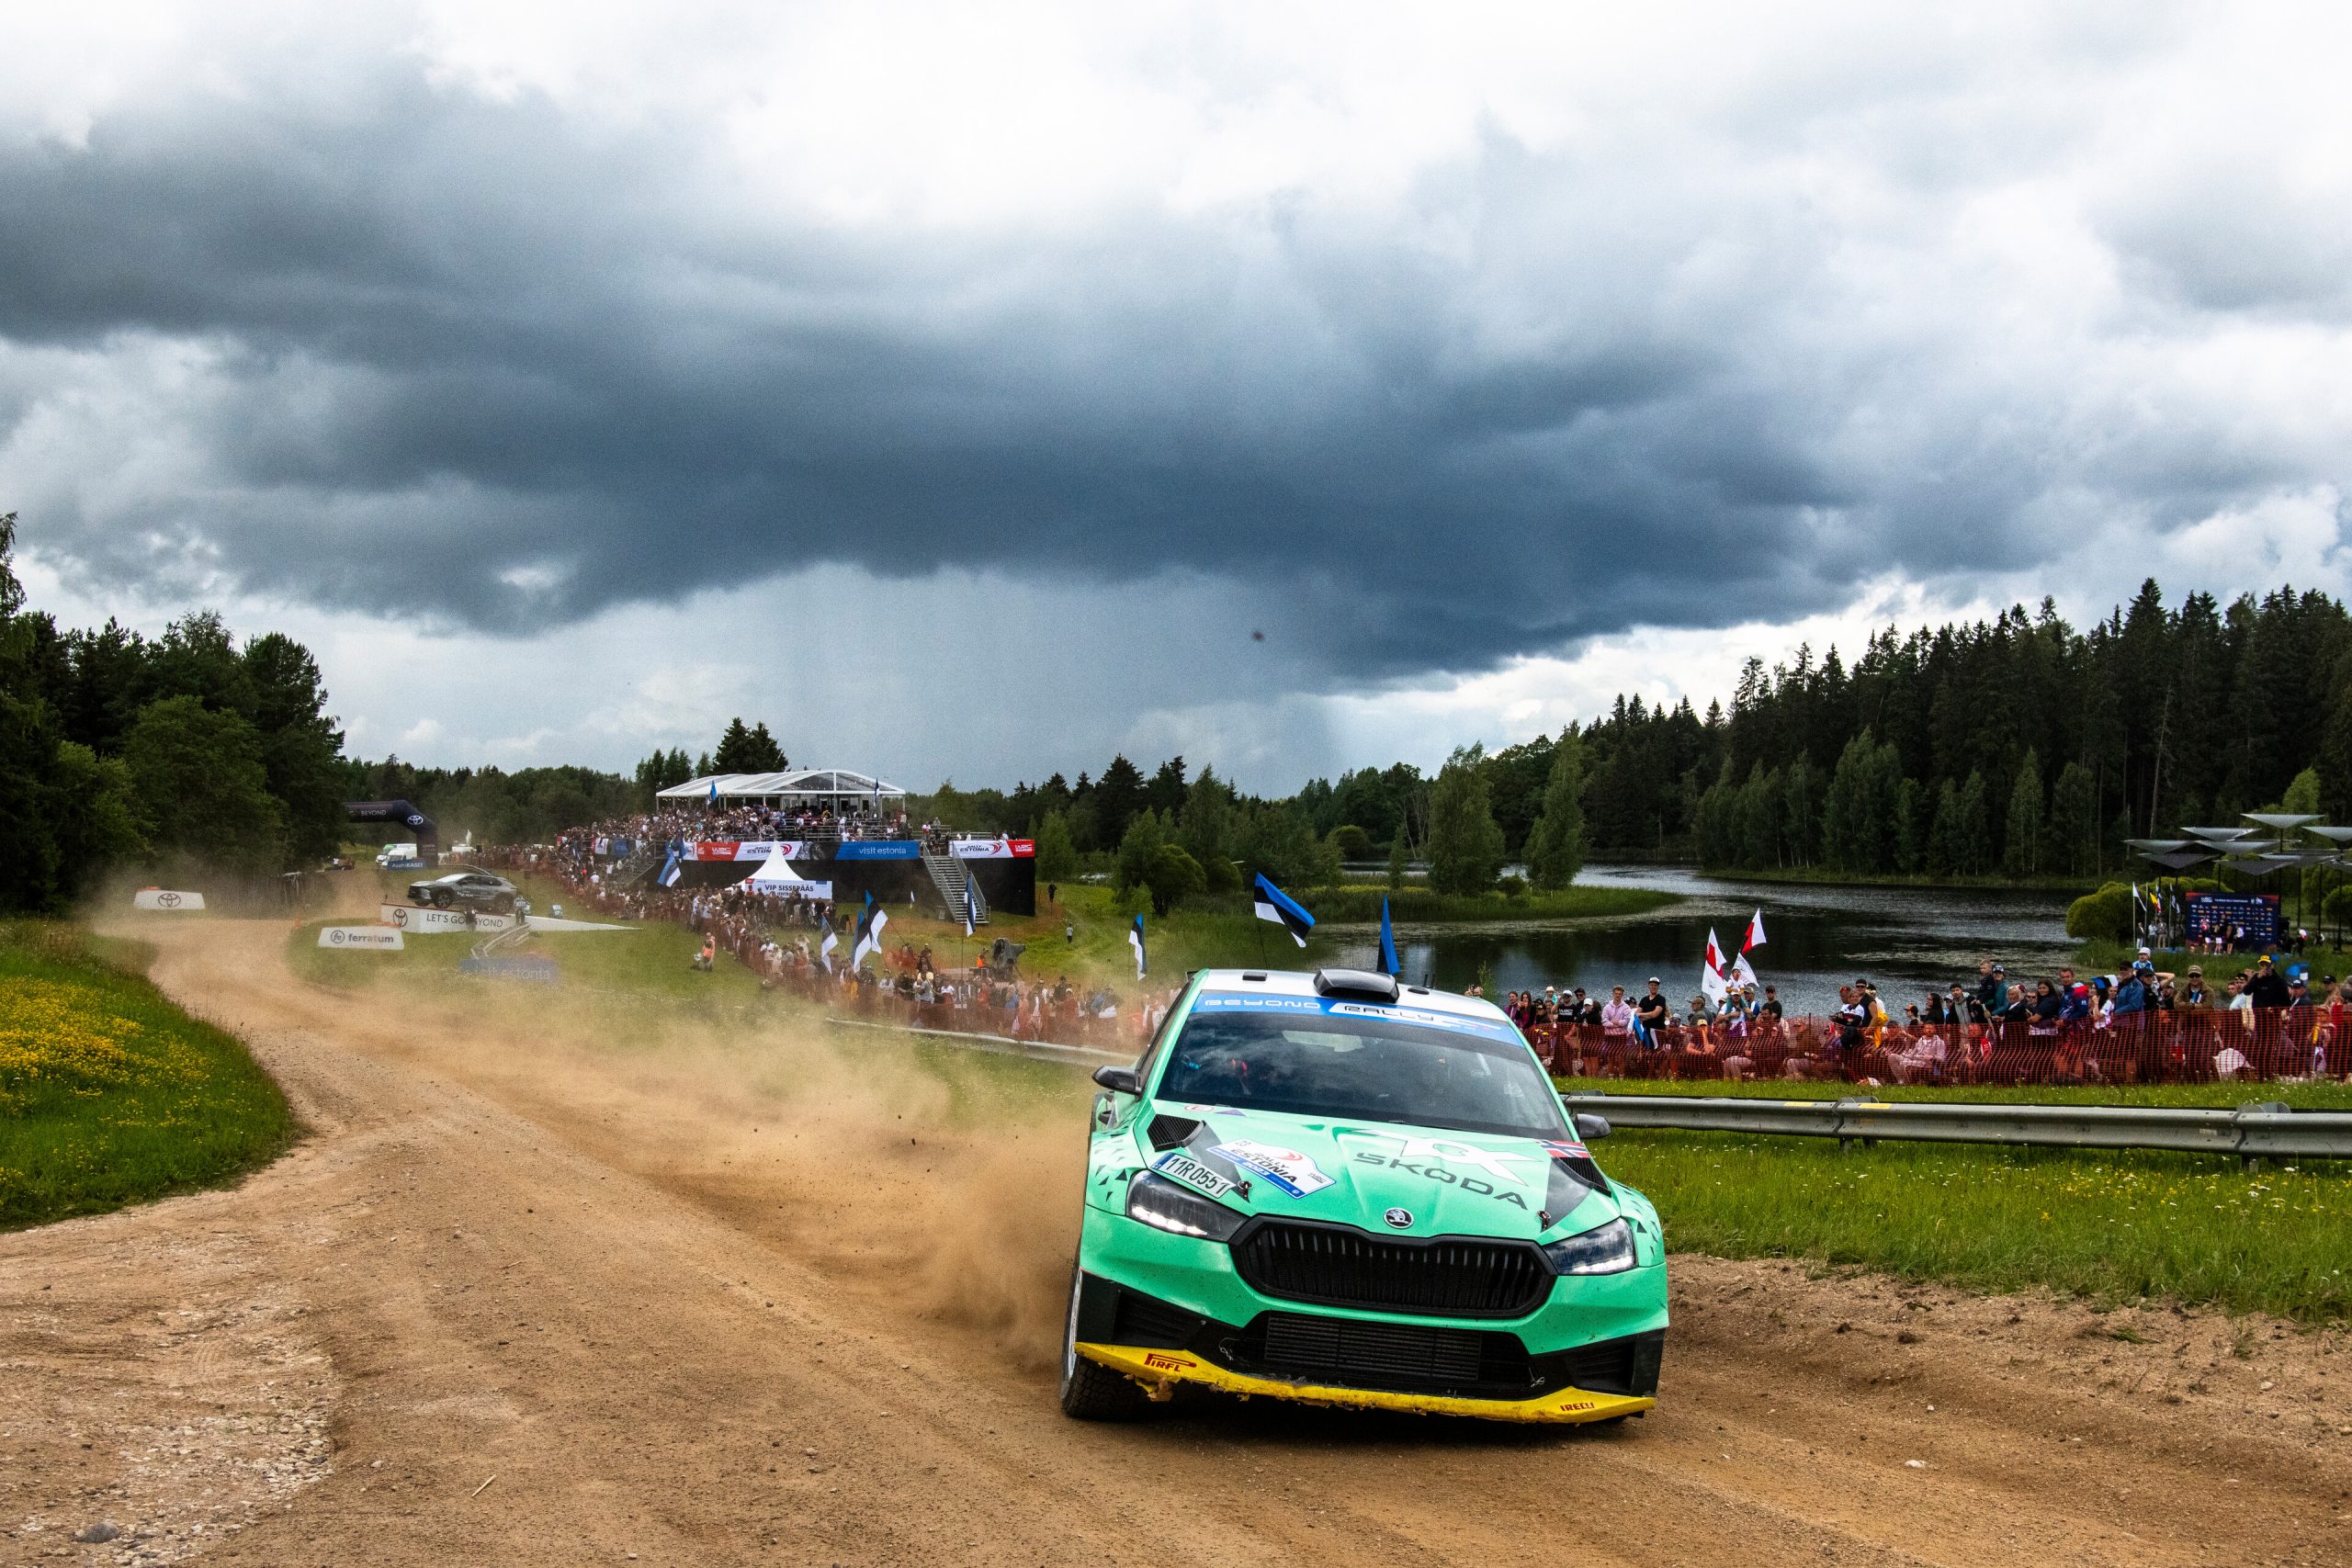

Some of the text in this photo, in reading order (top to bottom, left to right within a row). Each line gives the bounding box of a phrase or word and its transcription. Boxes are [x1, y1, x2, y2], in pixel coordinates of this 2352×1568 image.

[859, 846, 907, 855] visit estonia
[426, 913, 503, 928] LET'S GO YOND
[348, 933, 394, 943] ferratum
[1204, 998, 1435, 1021] BEYOND RALLY
[1230, 1148, 1298, 1183] ESTONIA
[1253, 1152, 1290, 1168] RALLY
